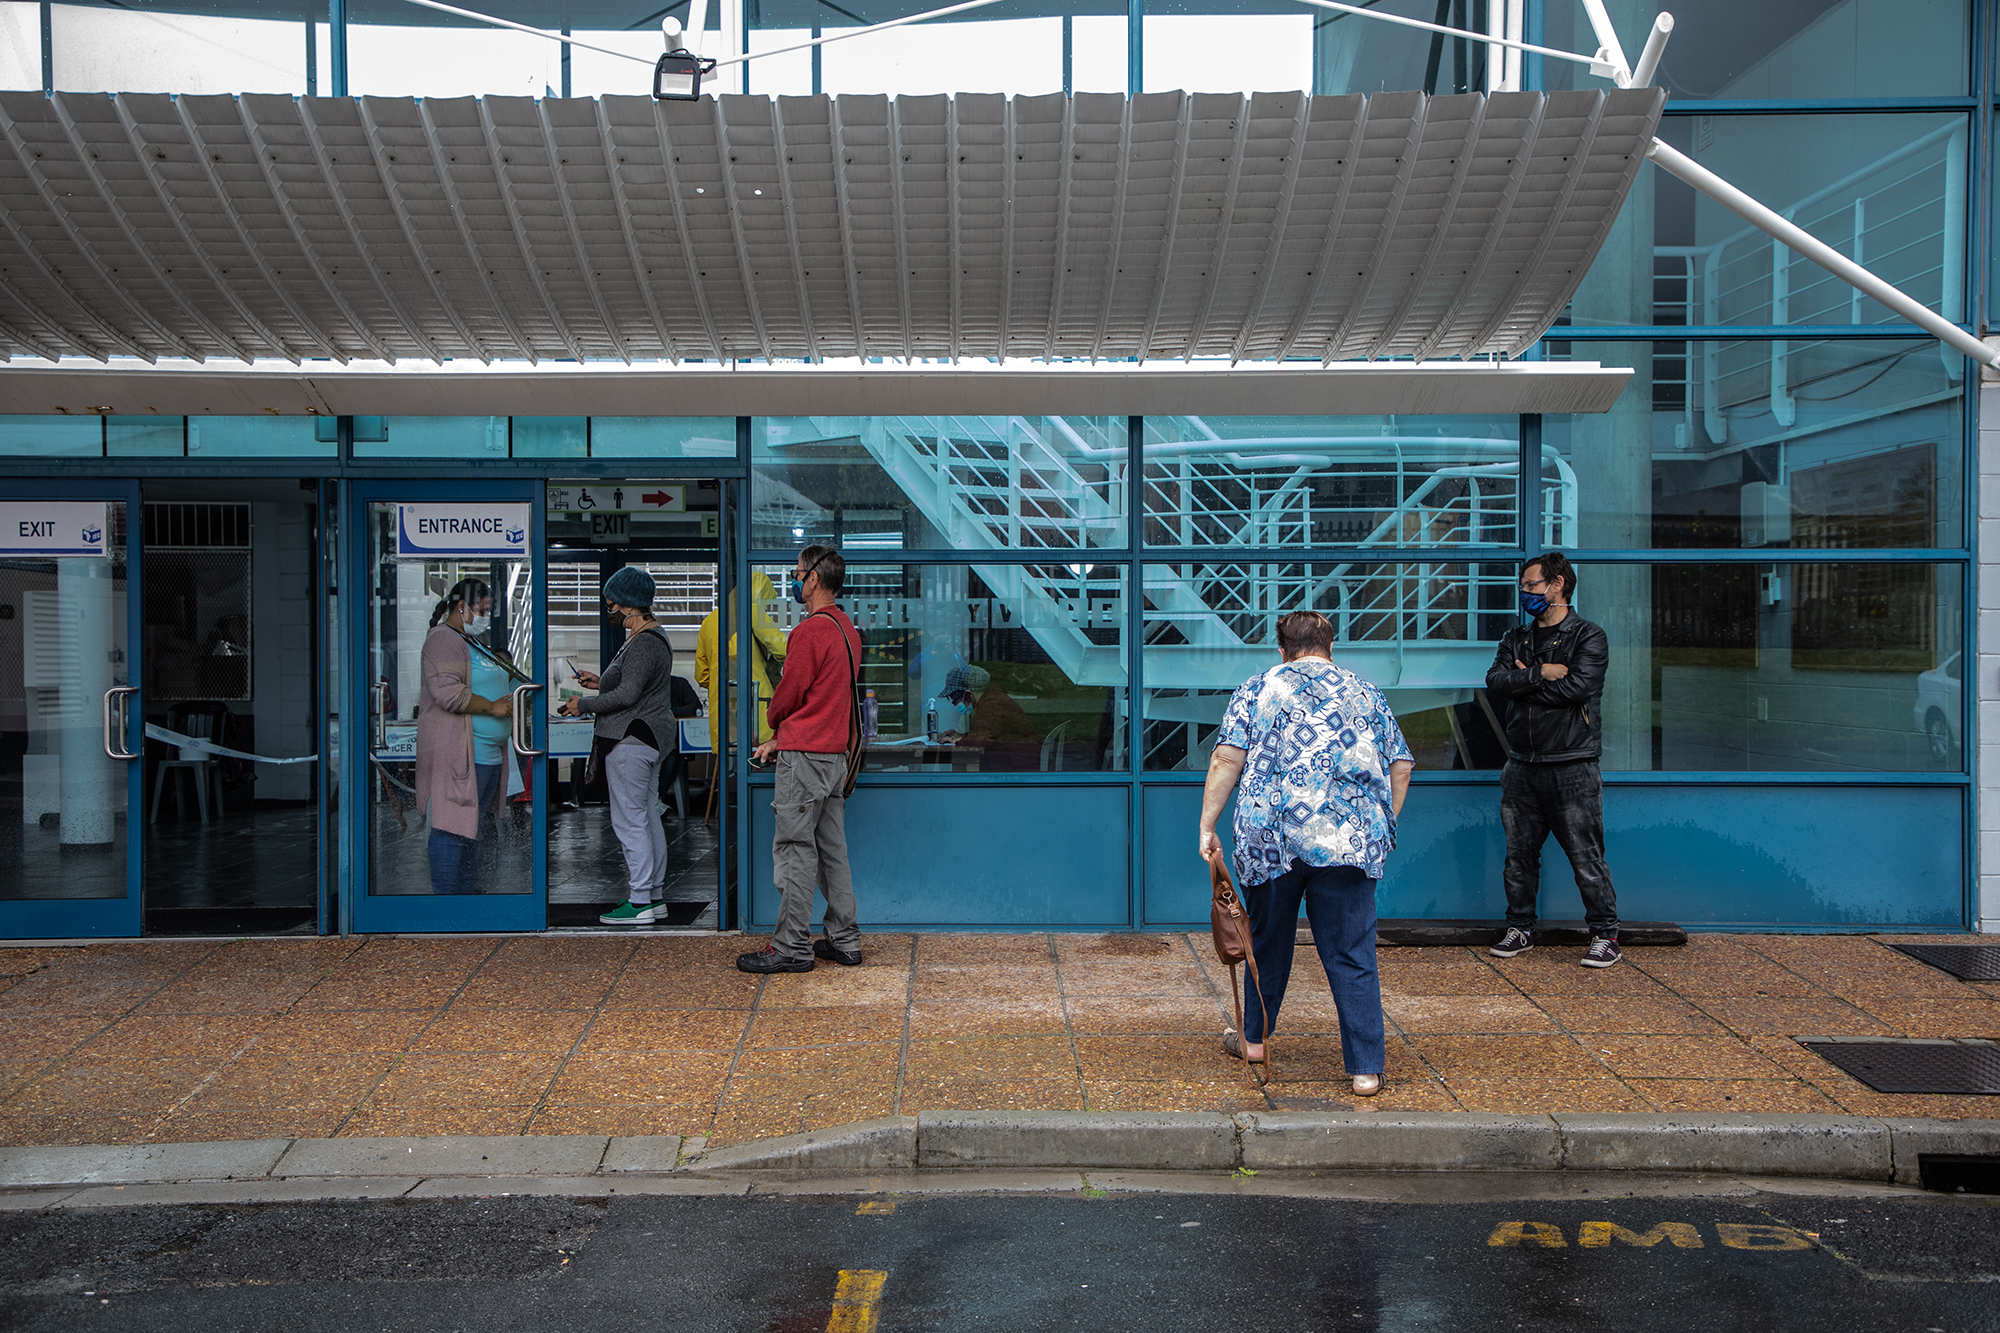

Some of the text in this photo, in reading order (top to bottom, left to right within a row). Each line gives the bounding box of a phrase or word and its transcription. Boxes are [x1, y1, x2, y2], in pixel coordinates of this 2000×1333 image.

[19, 521, 56, 537] EXIT
[418, 518, 503, 534] ENTRANCE
[593, 514, 627, 534] EXIT
[1487, 1221, 1813, 1250] AMB
